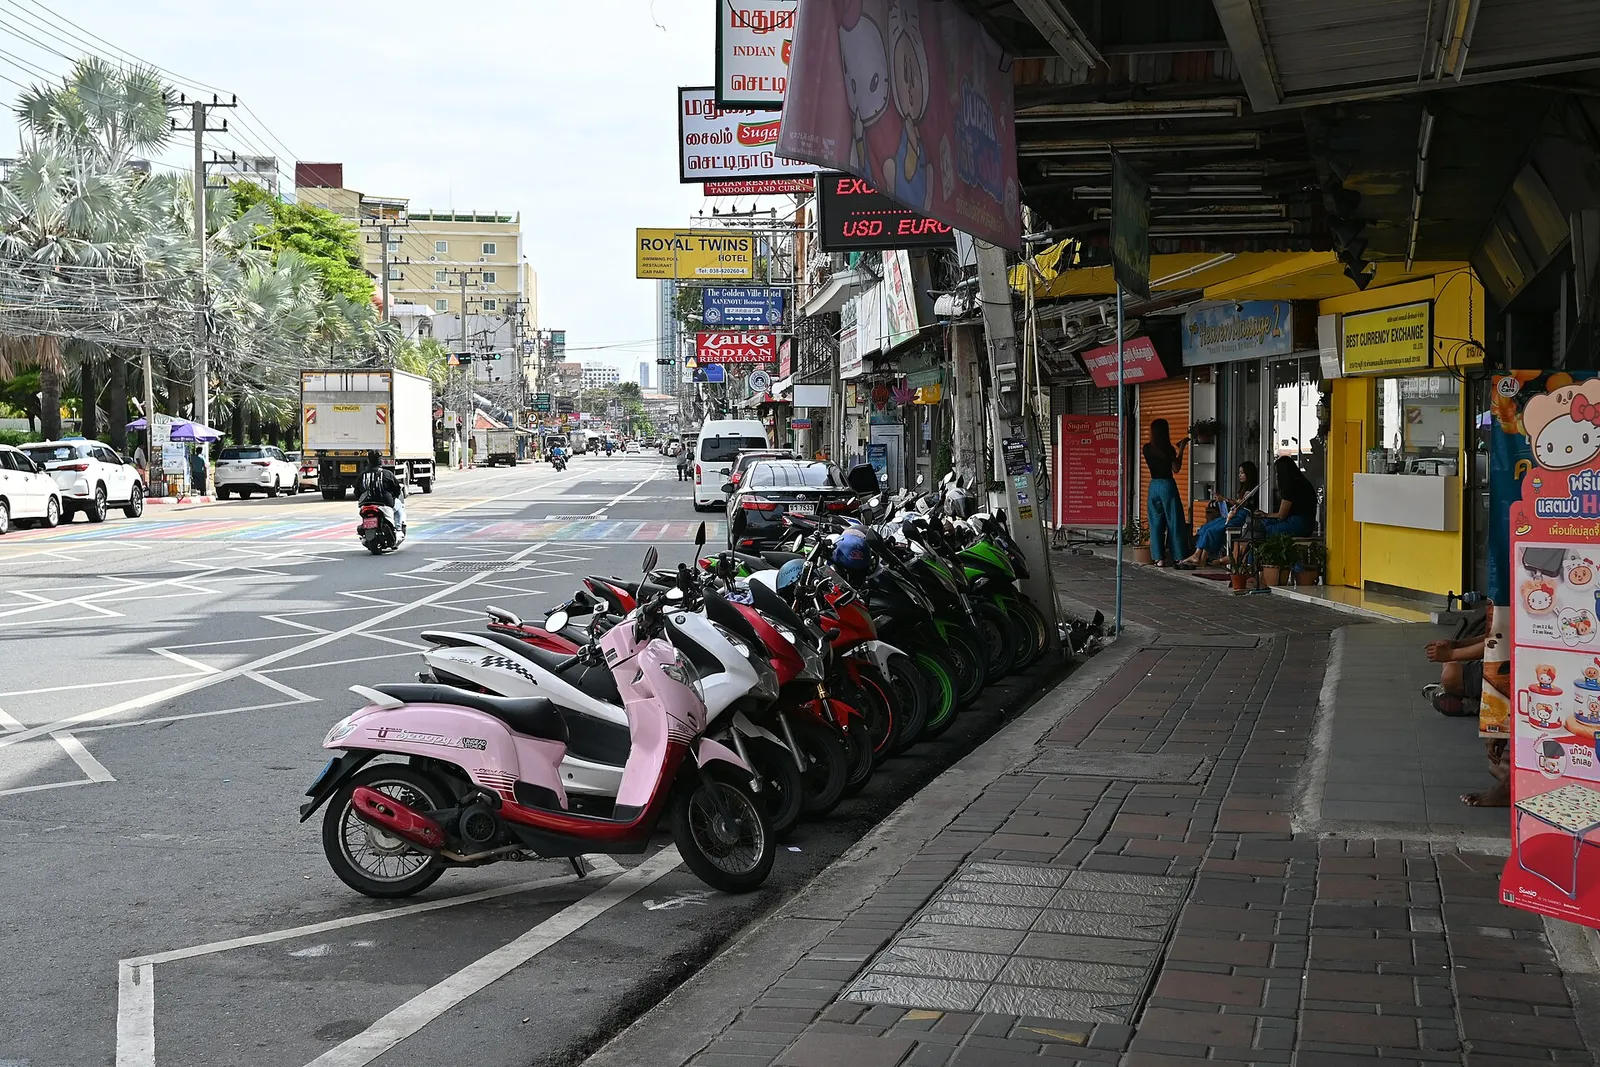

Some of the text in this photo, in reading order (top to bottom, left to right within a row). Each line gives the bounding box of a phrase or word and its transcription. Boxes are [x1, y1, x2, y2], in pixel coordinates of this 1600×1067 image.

[733, 45, 776, 57] INDIAN
[711, 186, 755, 194] TANDOORI
[778, 184, 806, 192] CURRY
[843, 220, 883, 237] USD
[641, 238, 749, 251] ROYAL TWINS
[718, 254, 748, 262] HOTEL
[707, 289, 720, 297] The
[721, 289, 745, 297] Golden
[747, 289, 761, 297] Ville
[1346, 324, 1424, 348] BEST CURRENCY EXCHANGE
[700, 348, 772, 357] INDIAN
[1582, 494, 1600, 514] H
[396, 730, 451, 746] Scoopy
